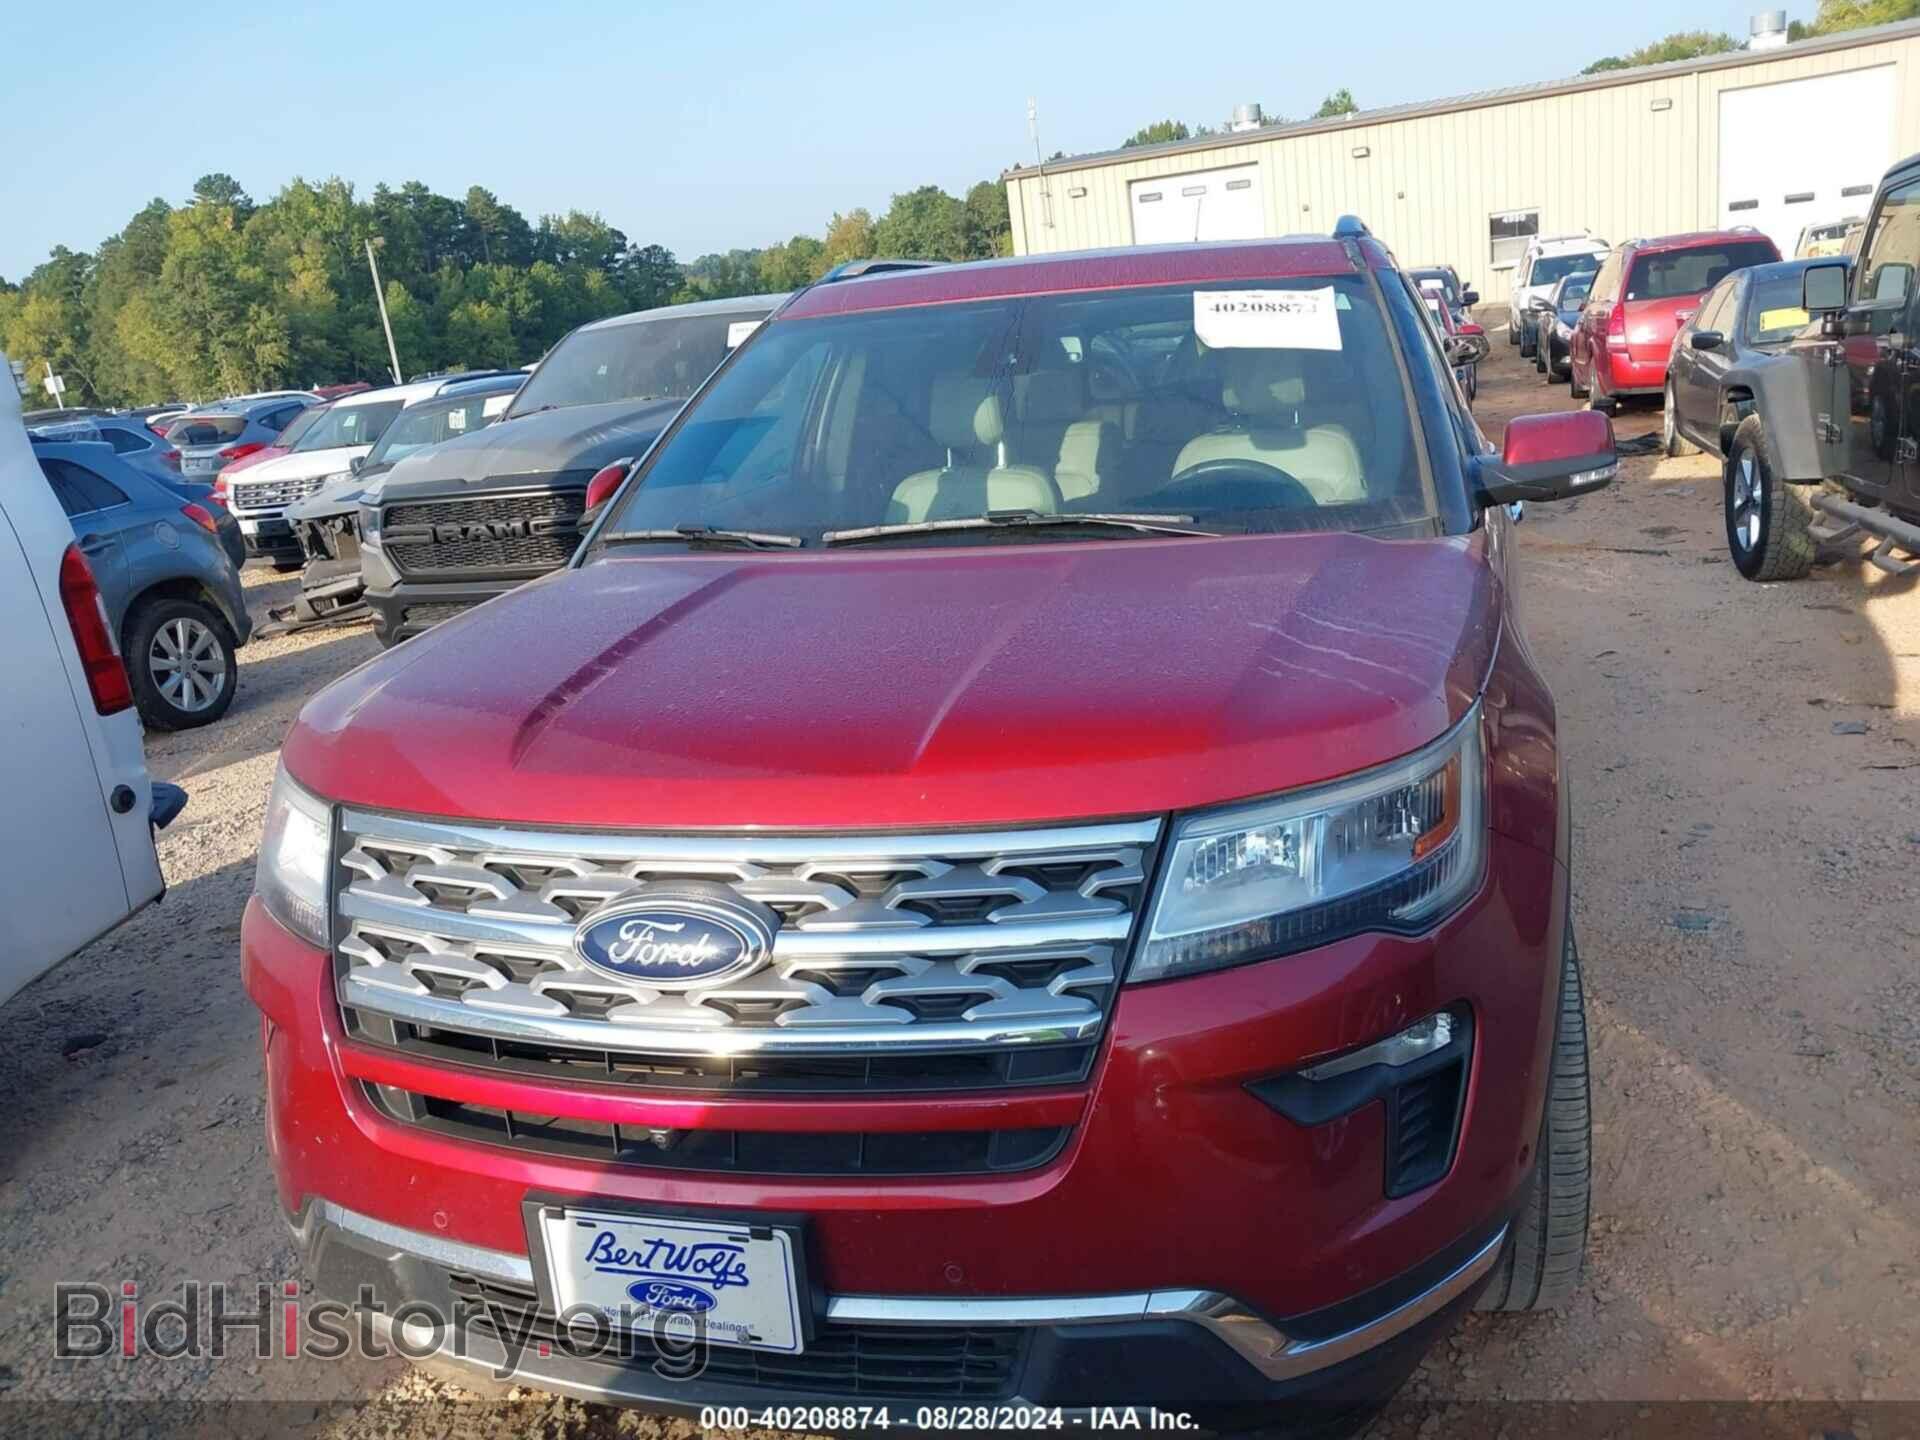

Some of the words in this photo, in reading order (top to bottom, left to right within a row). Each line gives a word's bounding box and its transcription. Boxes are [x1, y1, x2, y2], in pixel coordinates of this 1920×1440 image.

[434, 519, 530, 543] RAM
[607, 919, 715, 967] Ford
[585, 1231, 670, 1269] Bert
[645, 1283, 698, 1308] Ford
